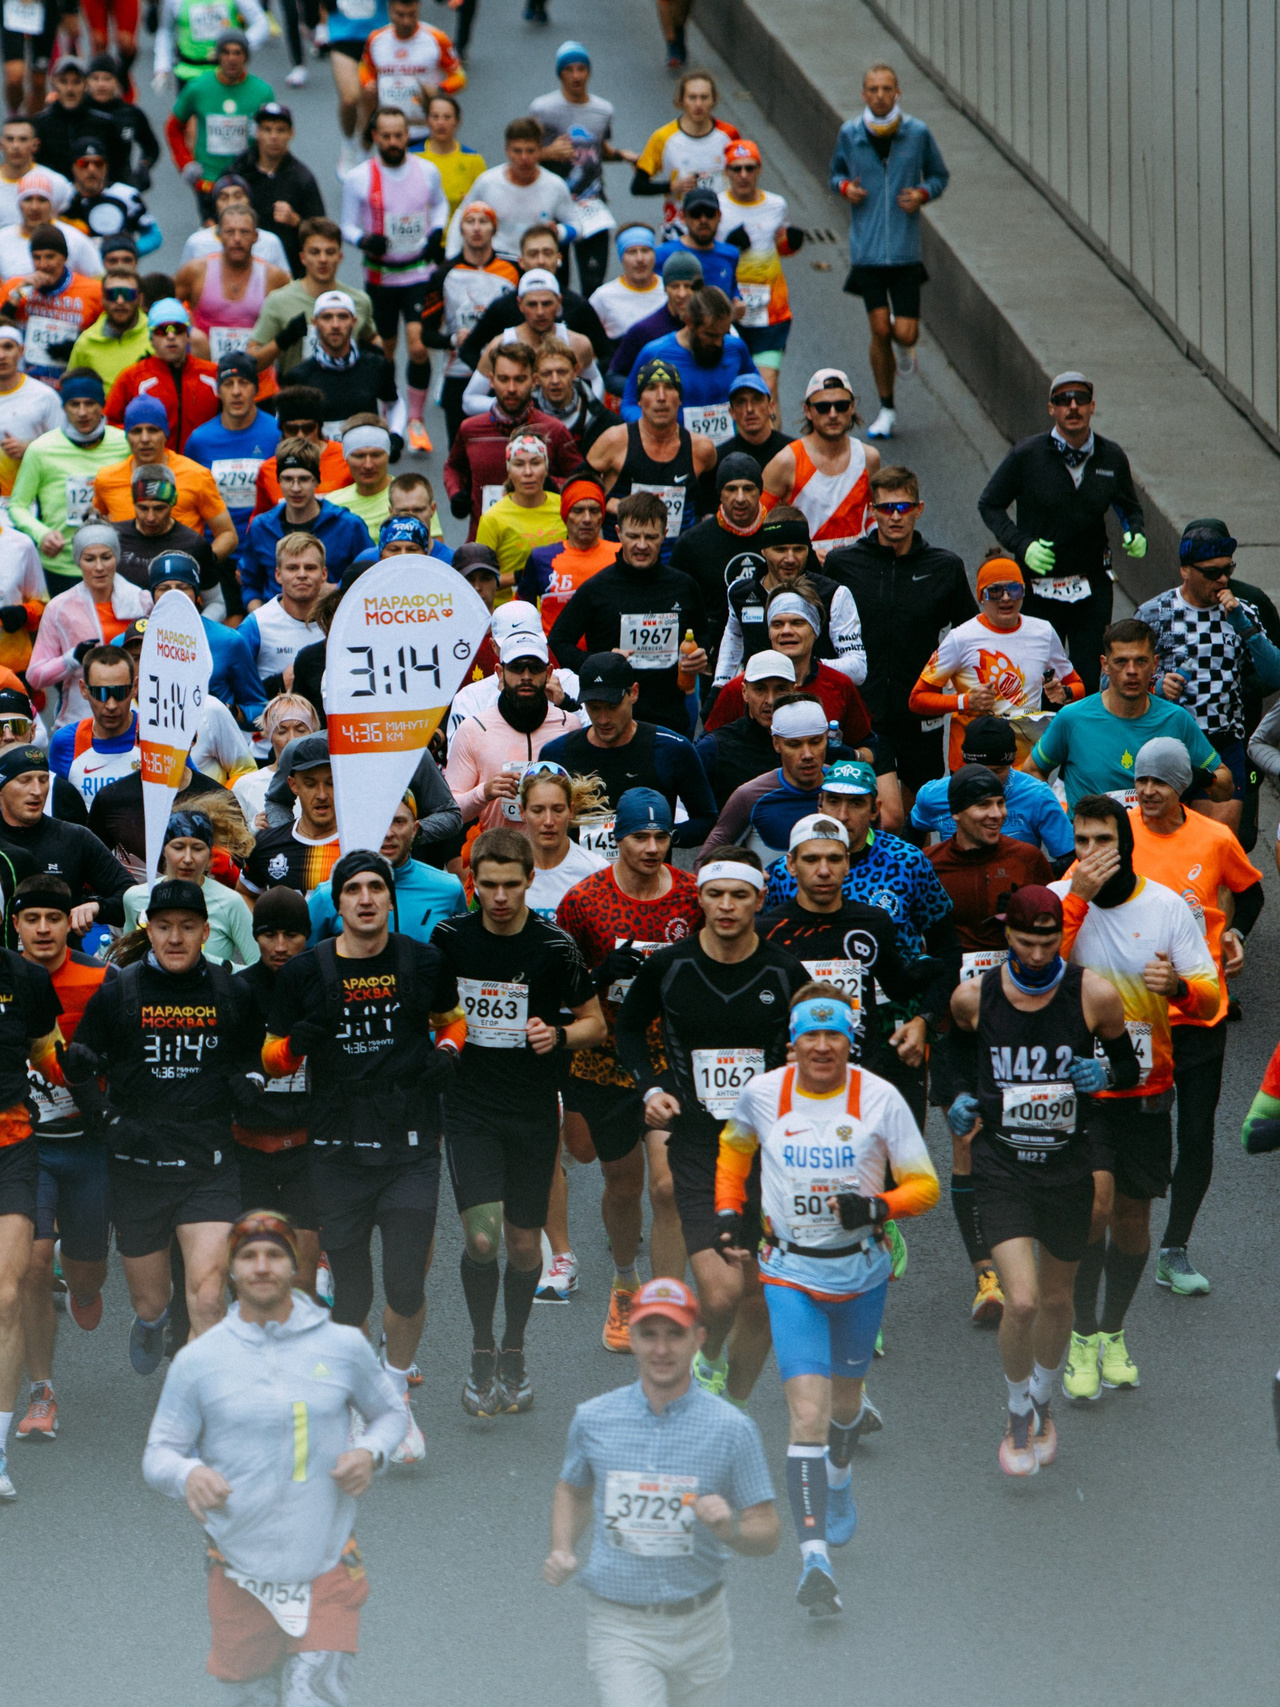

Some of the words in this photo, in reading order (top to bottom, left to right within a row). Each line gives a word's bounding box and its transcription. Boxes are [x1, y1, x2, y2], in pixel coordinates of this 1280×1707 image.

[691, 416, 729, 434] 5978
[363, 593, 453, 611] МАРАФОН
[365, 609, 440, 626] МОСКВА
[156, 628, 197, 649] МАРАФОН
[629, 628, 671, 646] 1967
[156, 642, 191, 663] МОСКВА
[346, 643, 442, 698] 3:14
[148, 674, 188, 732] 3:14
[341, 722, 384, 744] 4:36
[385, 731, 405, 742] КМ
[141, 1006, 217, 1018] МАРАФОН
[464, 996, 518, 1020] 9863
[141, 1017, 205, 1029] МОСКВА
[480, 1019, 499, 1027] ЕГОР
[143, 1034, 204, 1062] 3:14
[342, 1041, 367, 1055] 4:36
[151, 1066, 175, 1079] 4:36
[989, 1045, 1073, 1082] M42.2
[782, 1145, 856, 1169] RUSSIA
[1017, 1151, 1047, 1163] M42.2
[793, 1195, 834, 1216] 50
[617, 1493, 683, 1521] 3729
